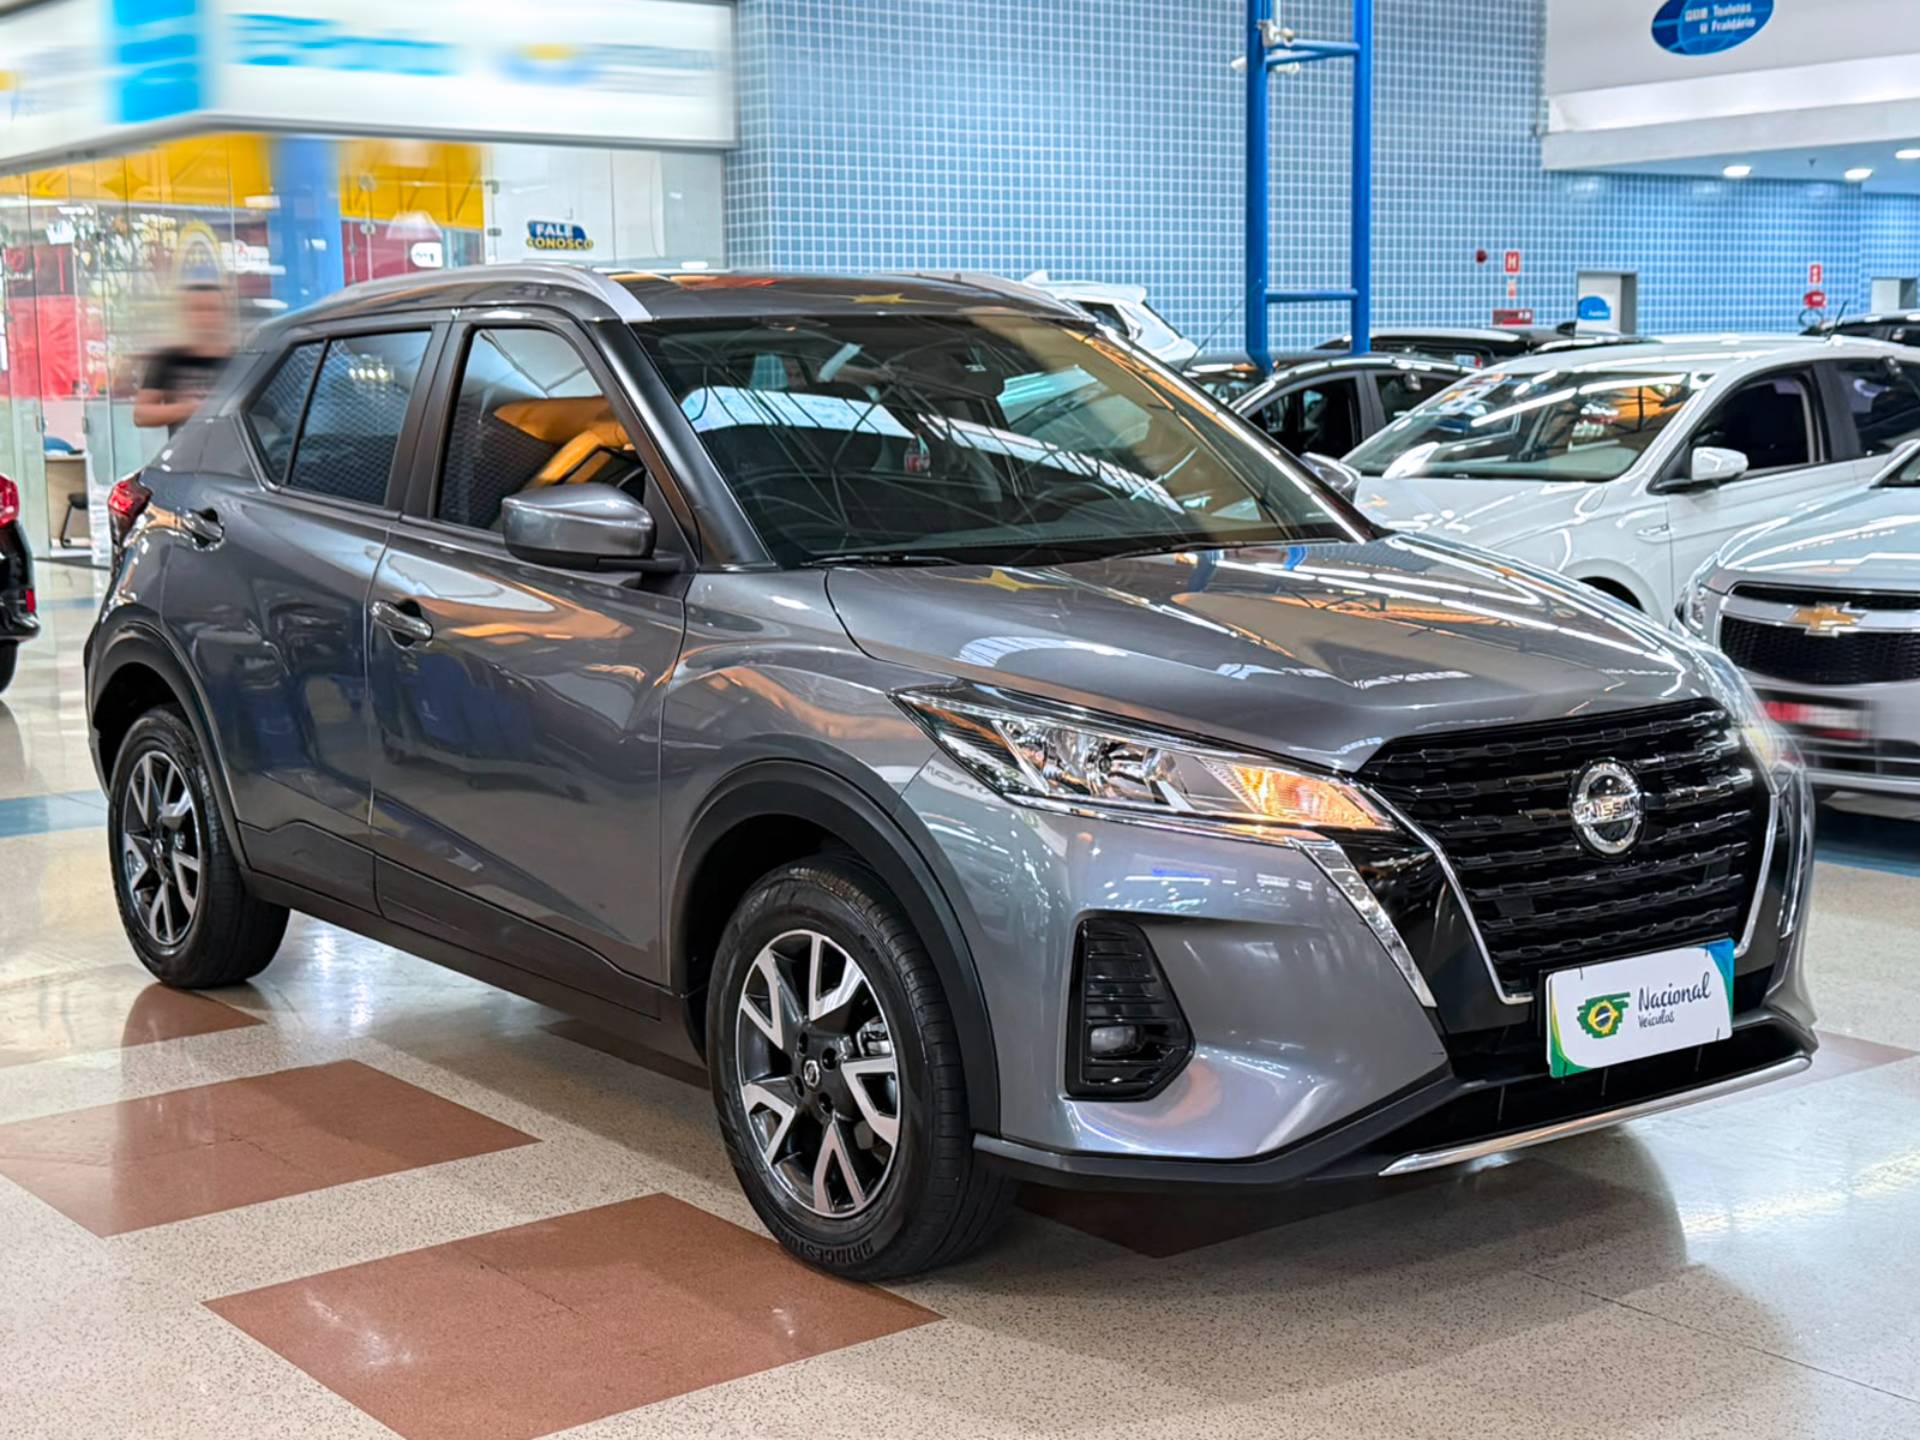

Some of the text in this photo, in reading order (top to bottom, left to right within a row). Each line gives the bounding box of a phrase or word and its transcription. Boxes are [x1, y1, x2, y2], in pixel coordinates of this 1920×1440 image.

[535, 223, 573, 237] FALE
[527, 237, 594, 250] CONOSCO
[1575, 797, 1639, 820] NISSAN
[1638, 971, 1711, 1012] Nacional
[1638, 1009, 1674, 1029] Veículos
